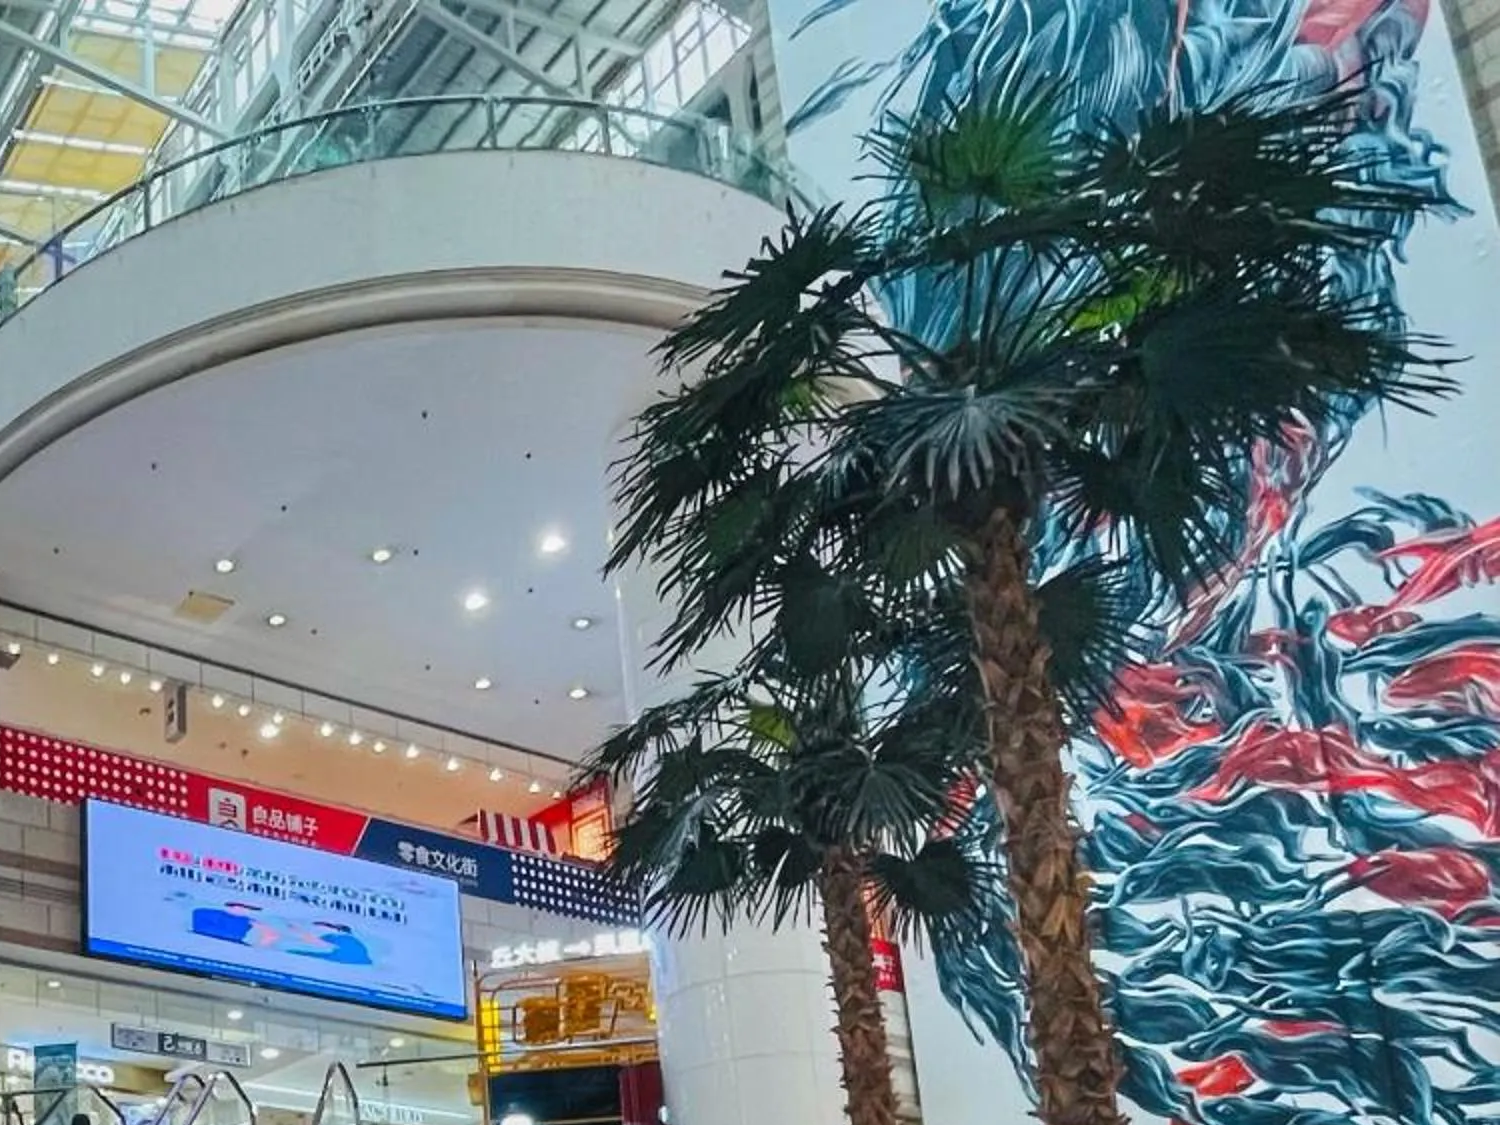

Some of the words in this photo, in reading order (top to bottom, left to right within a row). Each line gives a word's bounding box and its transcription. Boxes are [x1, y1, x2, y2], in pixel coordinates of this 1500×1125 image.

[397, 840, 479, 878] 零食文化街
